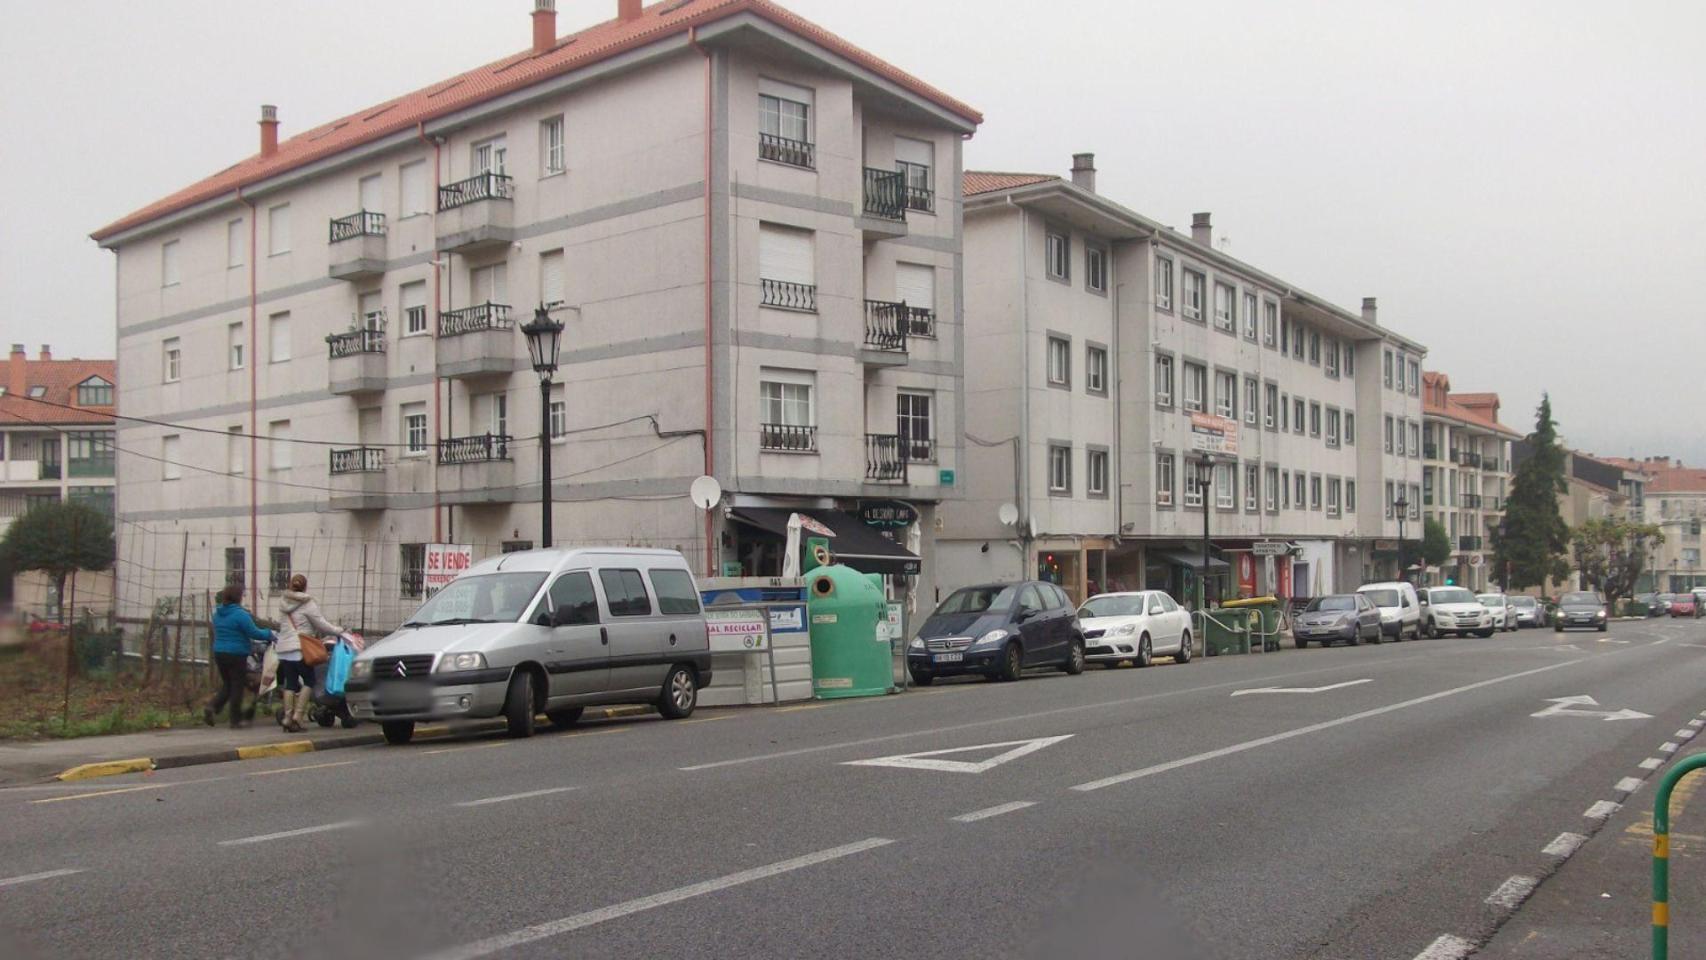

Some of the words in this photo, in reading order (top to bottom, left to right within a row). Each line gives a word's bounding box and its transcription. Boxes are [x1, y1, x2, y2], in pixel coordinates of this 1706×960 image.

[428, 552, 439, 569] SE
[442, 552, 469, 569] VENDE
[724, 623, 762, 633] RECICLAR
